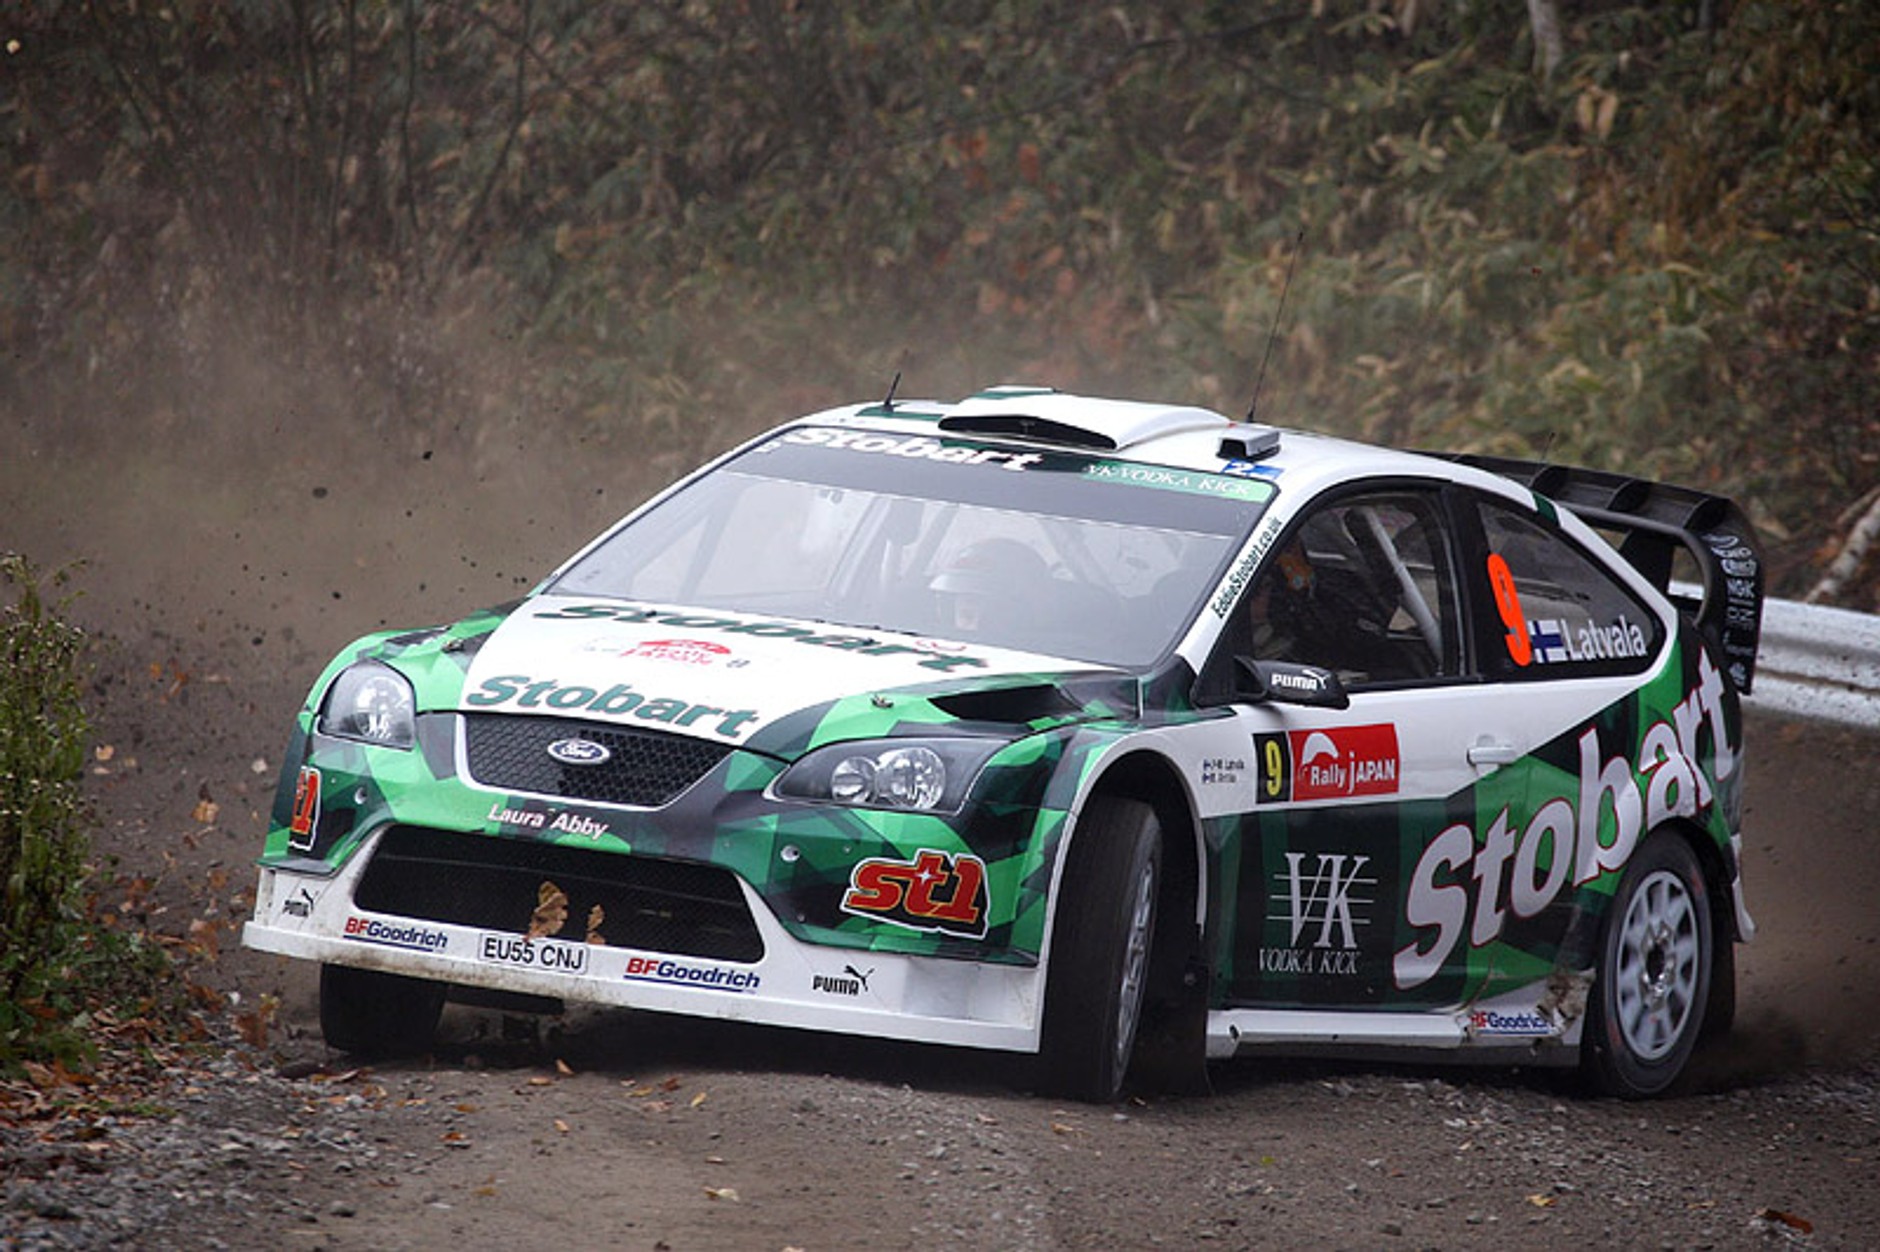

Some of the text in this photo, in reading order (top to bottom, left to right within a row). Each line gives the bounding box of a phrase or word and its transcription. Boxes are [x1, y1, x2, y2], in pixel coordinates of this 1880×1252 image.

[781, 428, 1044, 472] Stobart
[1120, 467, 1190, 487] VODKA
[1199, 478, 1250, 495] KICK
[1487, 553, 1532, 667] 9
[532, 604, 989, 673] Stobart
[1560, 613, 1649, 661] Latvala
[466, 675, 759, 738] Stobart
[1265, 740, 1282, 796] 9
[1310, 765, 1347, 788] Rally
[487, 803, 610, 841] Laura Abby
[1392, 645, 1734, 991] Stobart
[1284, 852, 1371, 949] VK
[344, 916, 449, 949] BFGoodrich
[484, 936, 585, 970] EU55 CNJ
[626, 956, 761, 988] BFGoodrich
[1259, 948, 1361, 974] VODKA KICK
